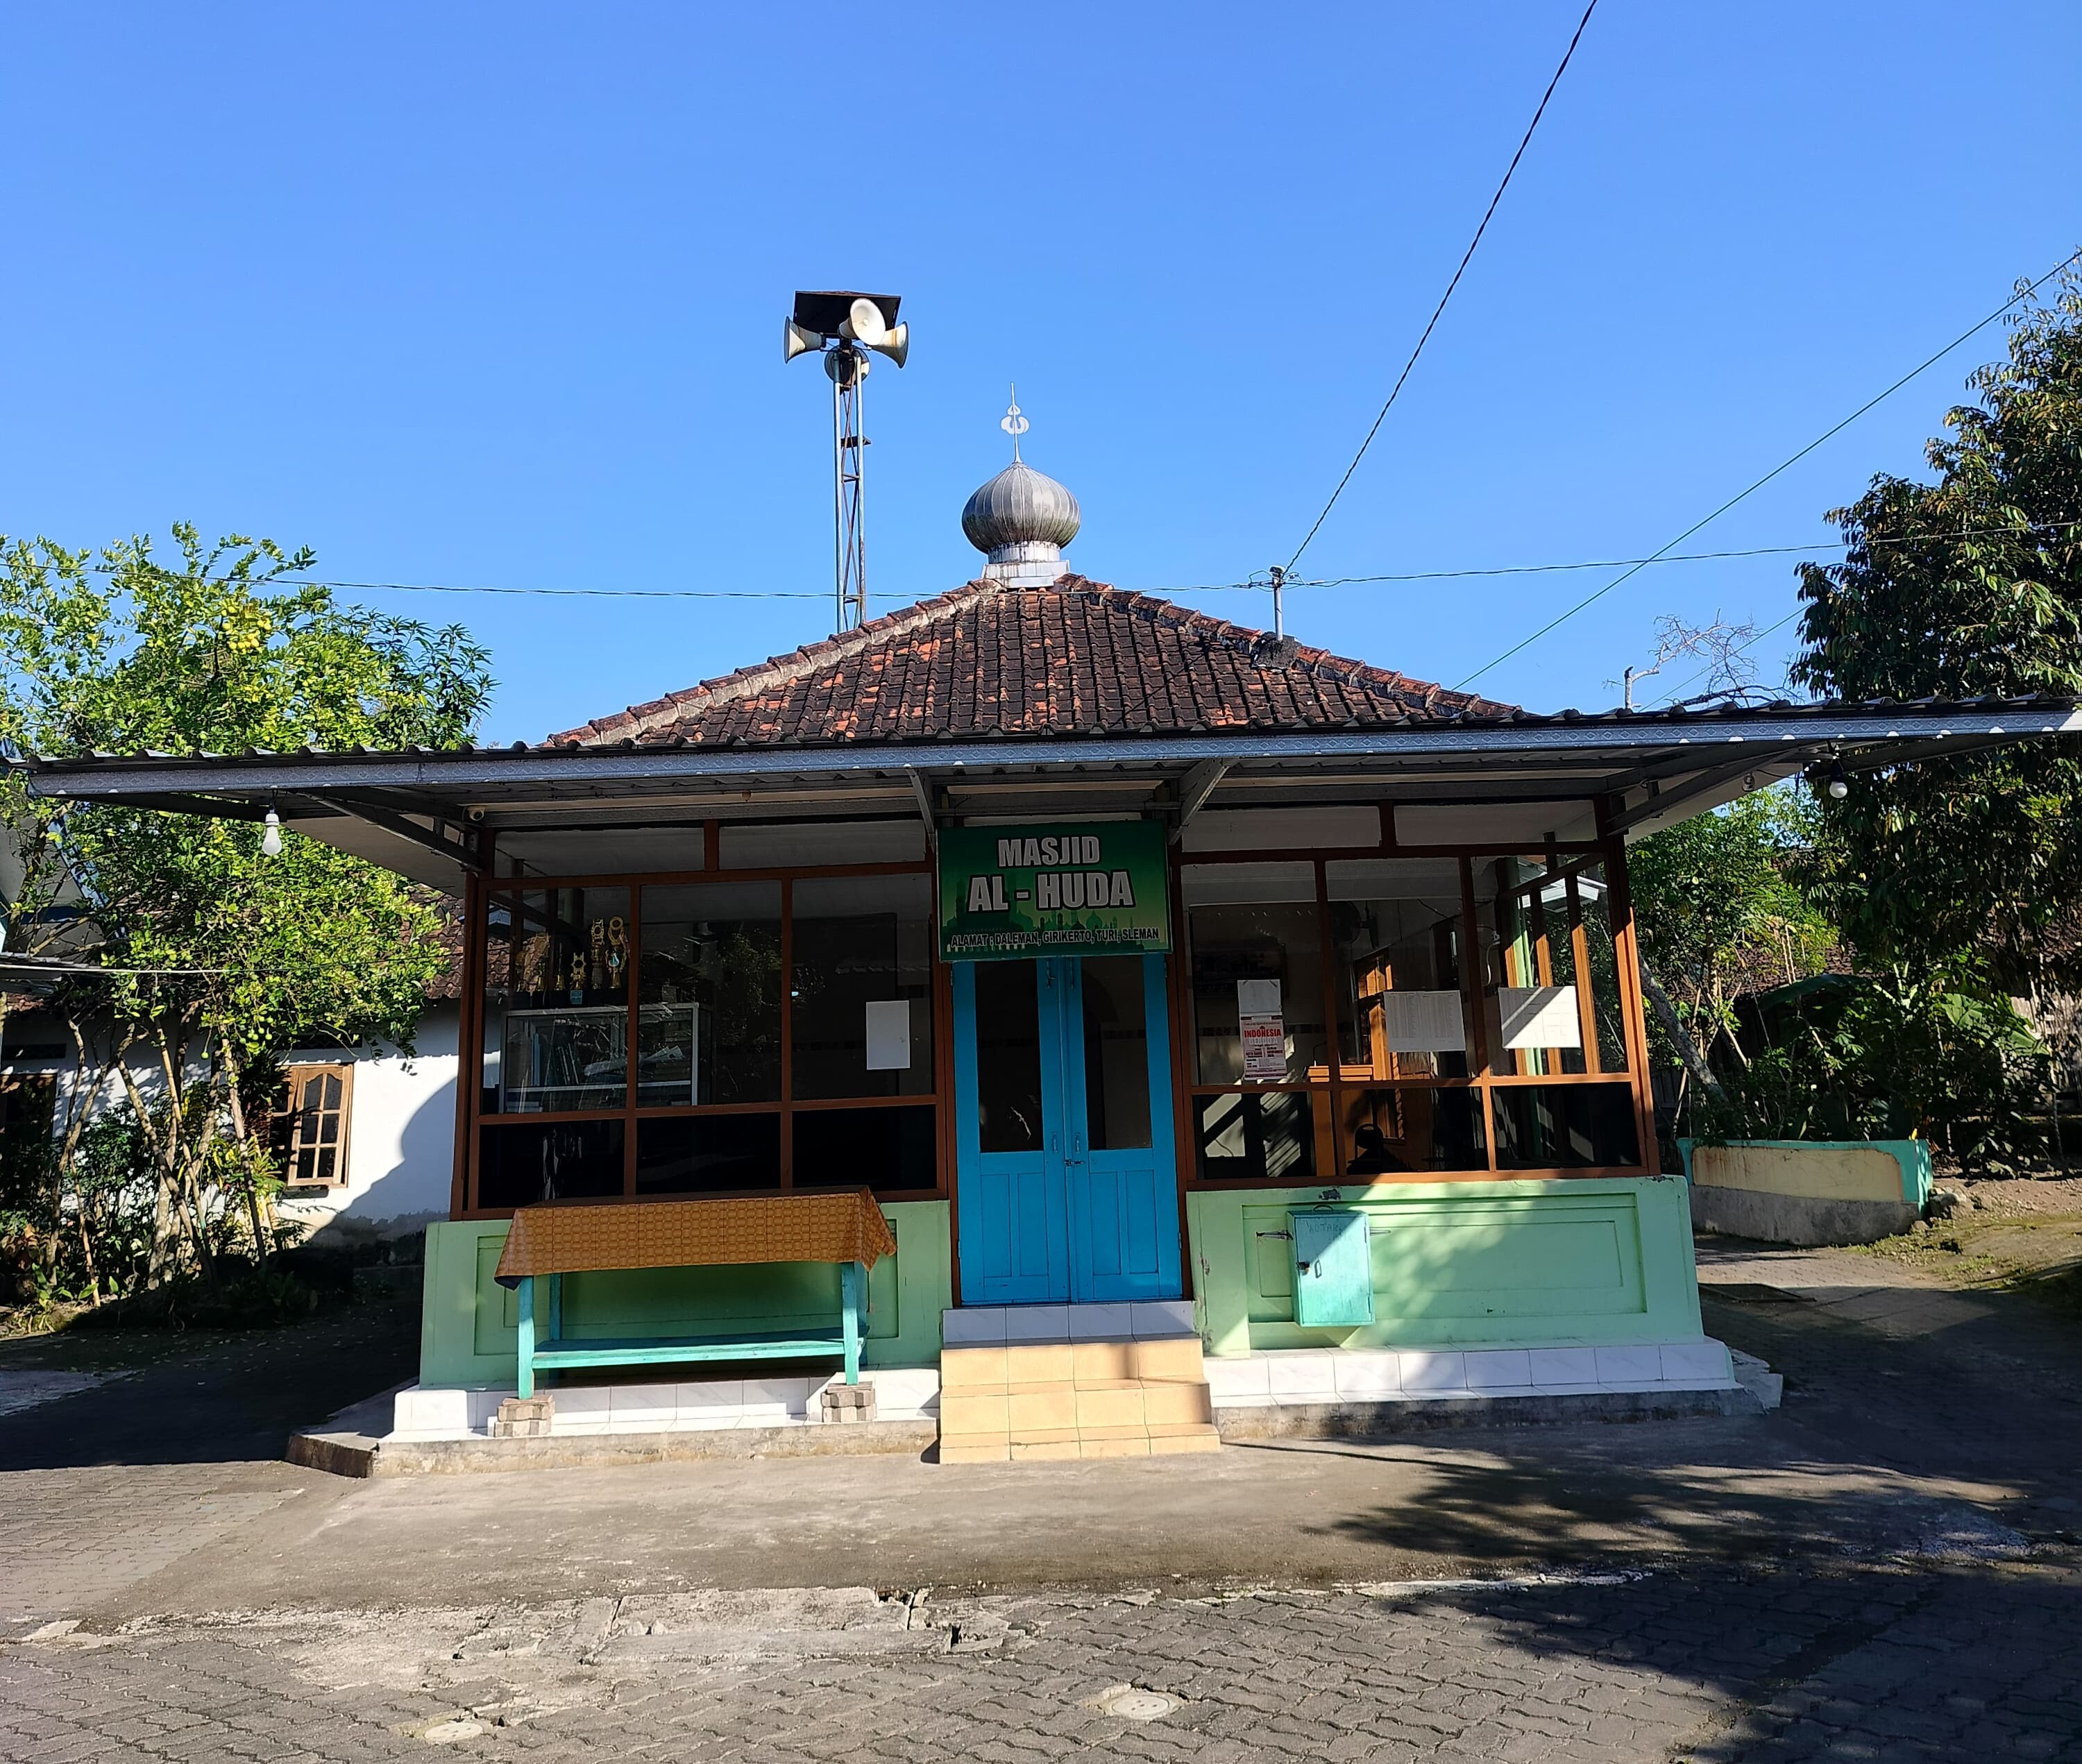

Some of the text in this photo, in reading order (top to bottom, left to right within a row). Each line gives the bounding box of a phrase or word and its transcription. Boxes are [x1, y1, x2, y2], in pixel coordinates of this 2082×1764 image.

[997, 836, 1100, 867] MASJID
[968, 876, 1008, 912] AL
[1038, 871, 1134, 908] HUDA
[951, 934, 988, 947] ALAMAT
[995, 931, 1041, 947] DALEMAN,
[1042, 929, 1094, 944] GIRIKERTO,
[1095, 928, 1121, 943] TURI,
[1122, 927, 1160, 940] SLEMAN
[1244, 1029, 1281, 1037] INDONESIA
